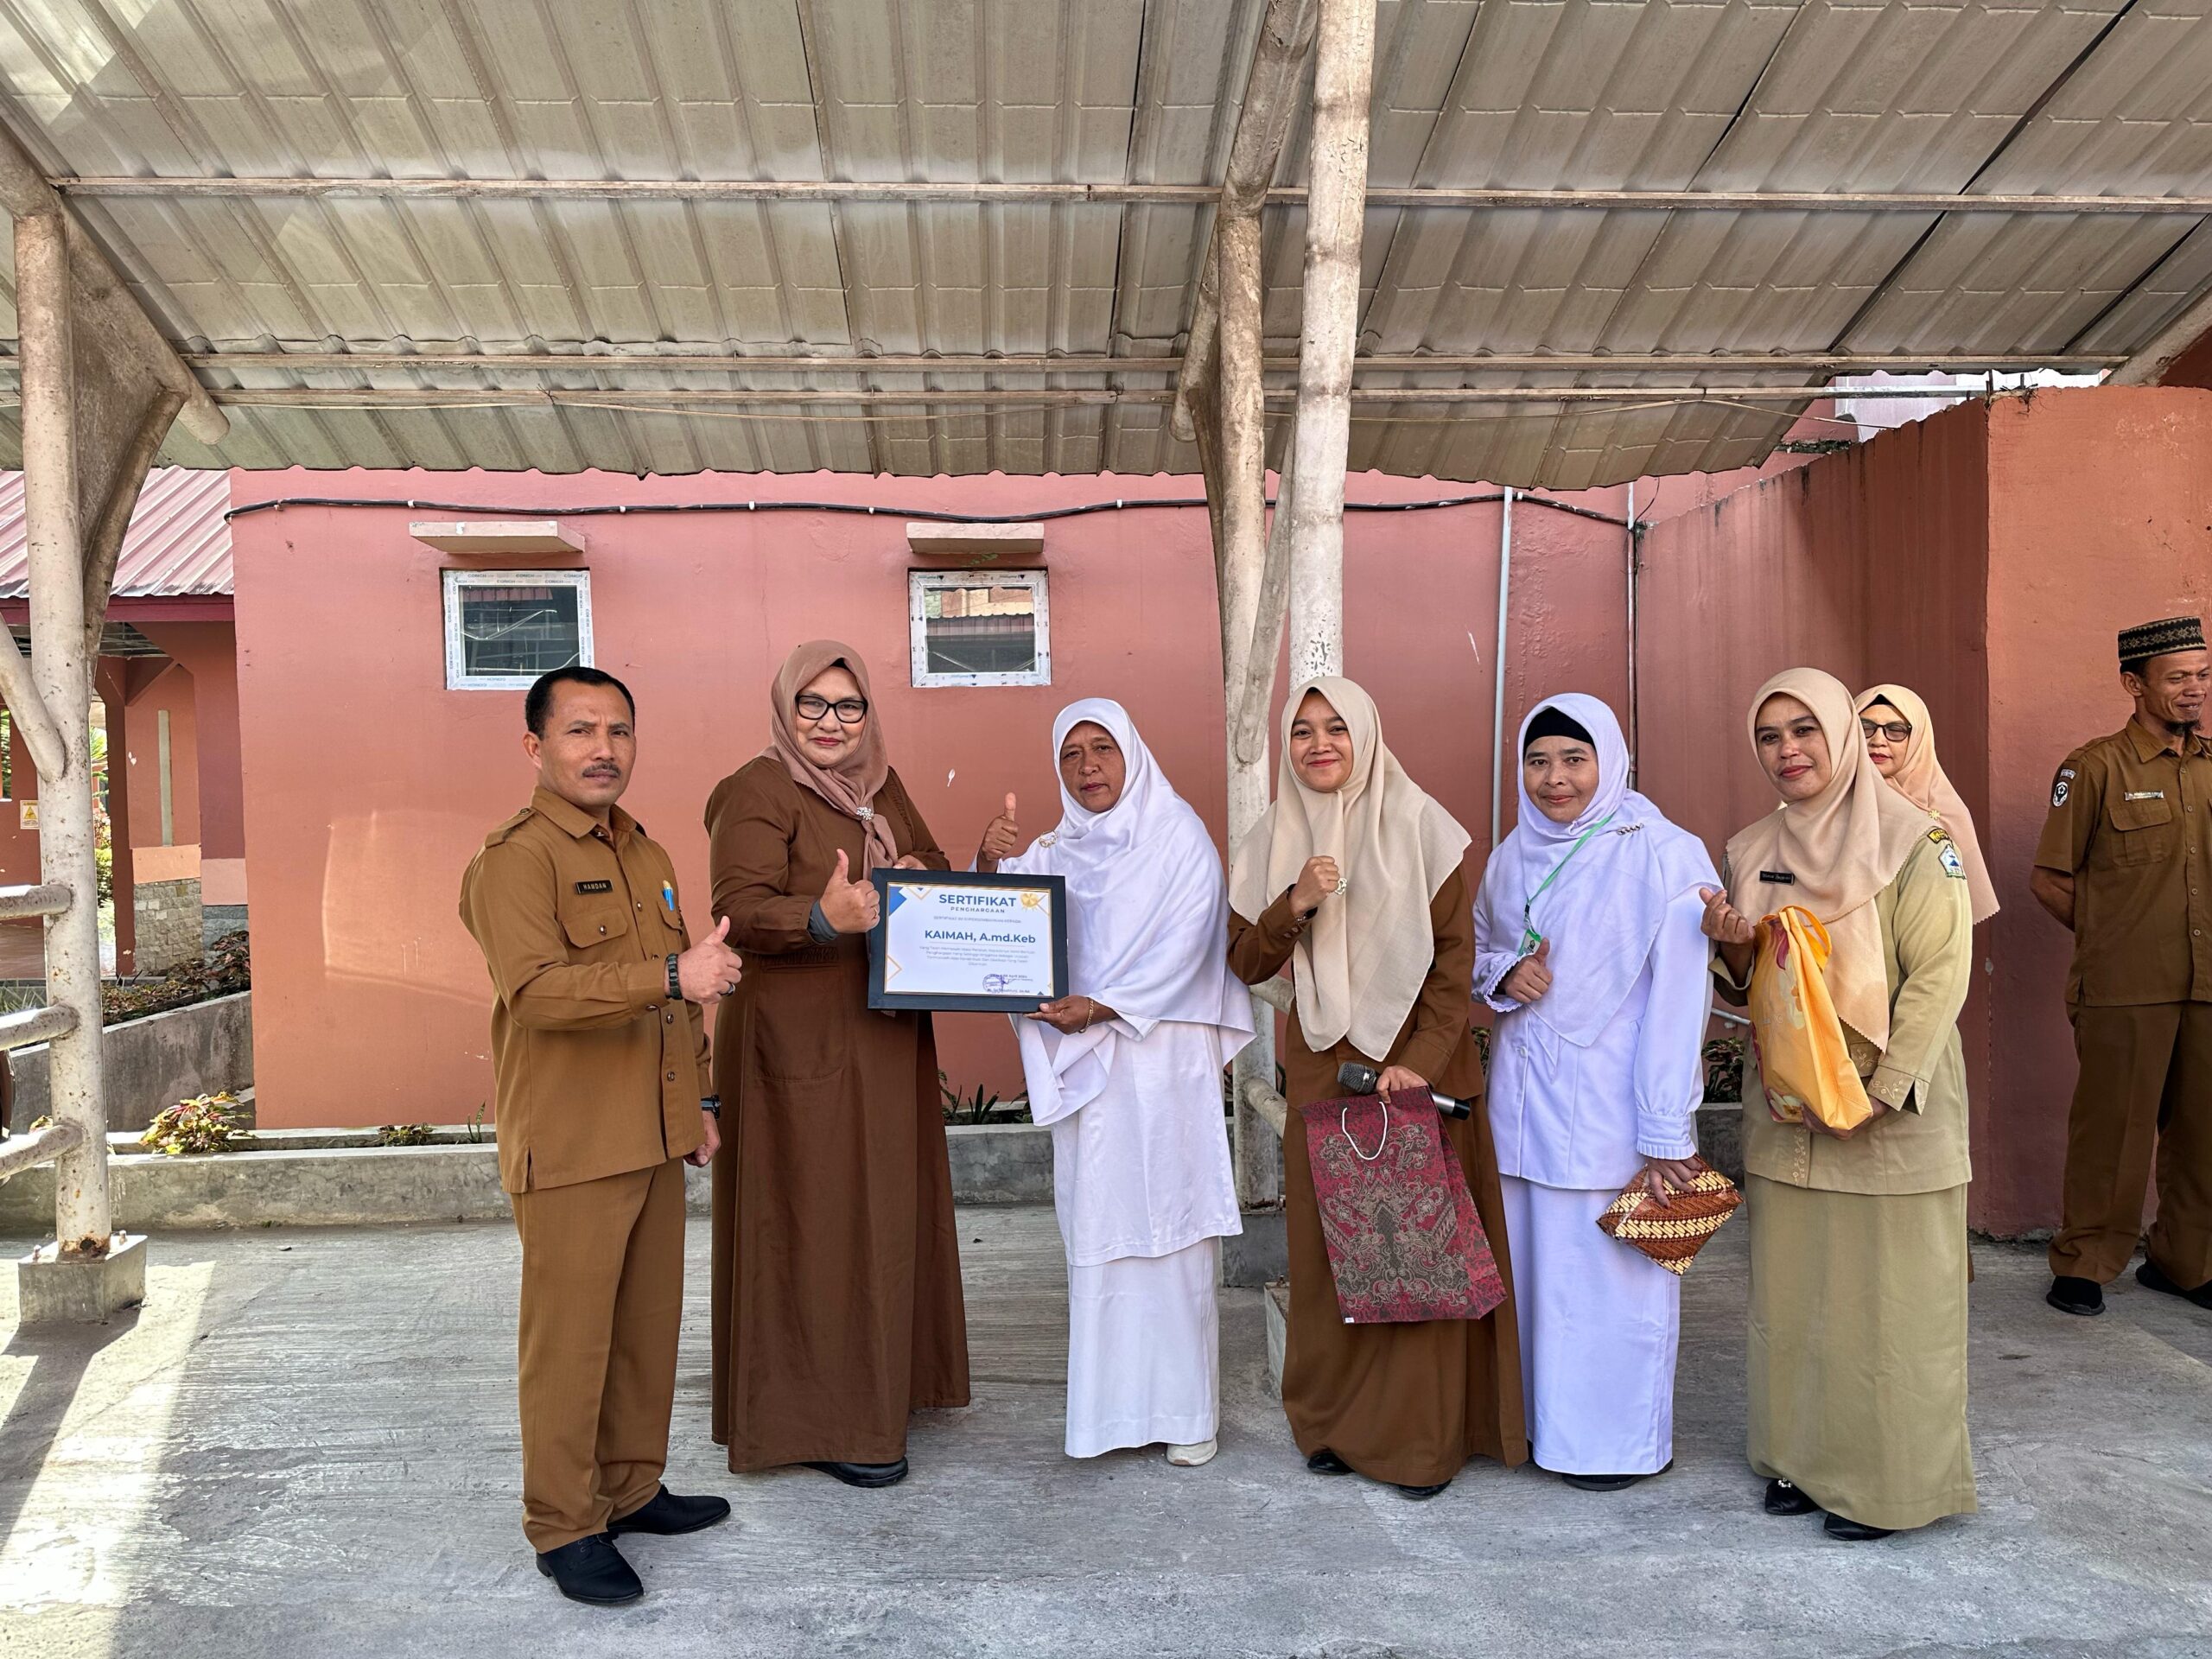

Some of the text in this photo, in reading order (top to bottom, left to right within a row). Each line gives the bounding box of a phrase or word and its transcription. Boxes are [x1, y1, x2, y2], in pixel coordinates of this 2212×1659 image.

[939, 894, 1016, 907] SERTIFIKAT
[925, 930, 1036, 944] KAIMAH, A.md.Keb
